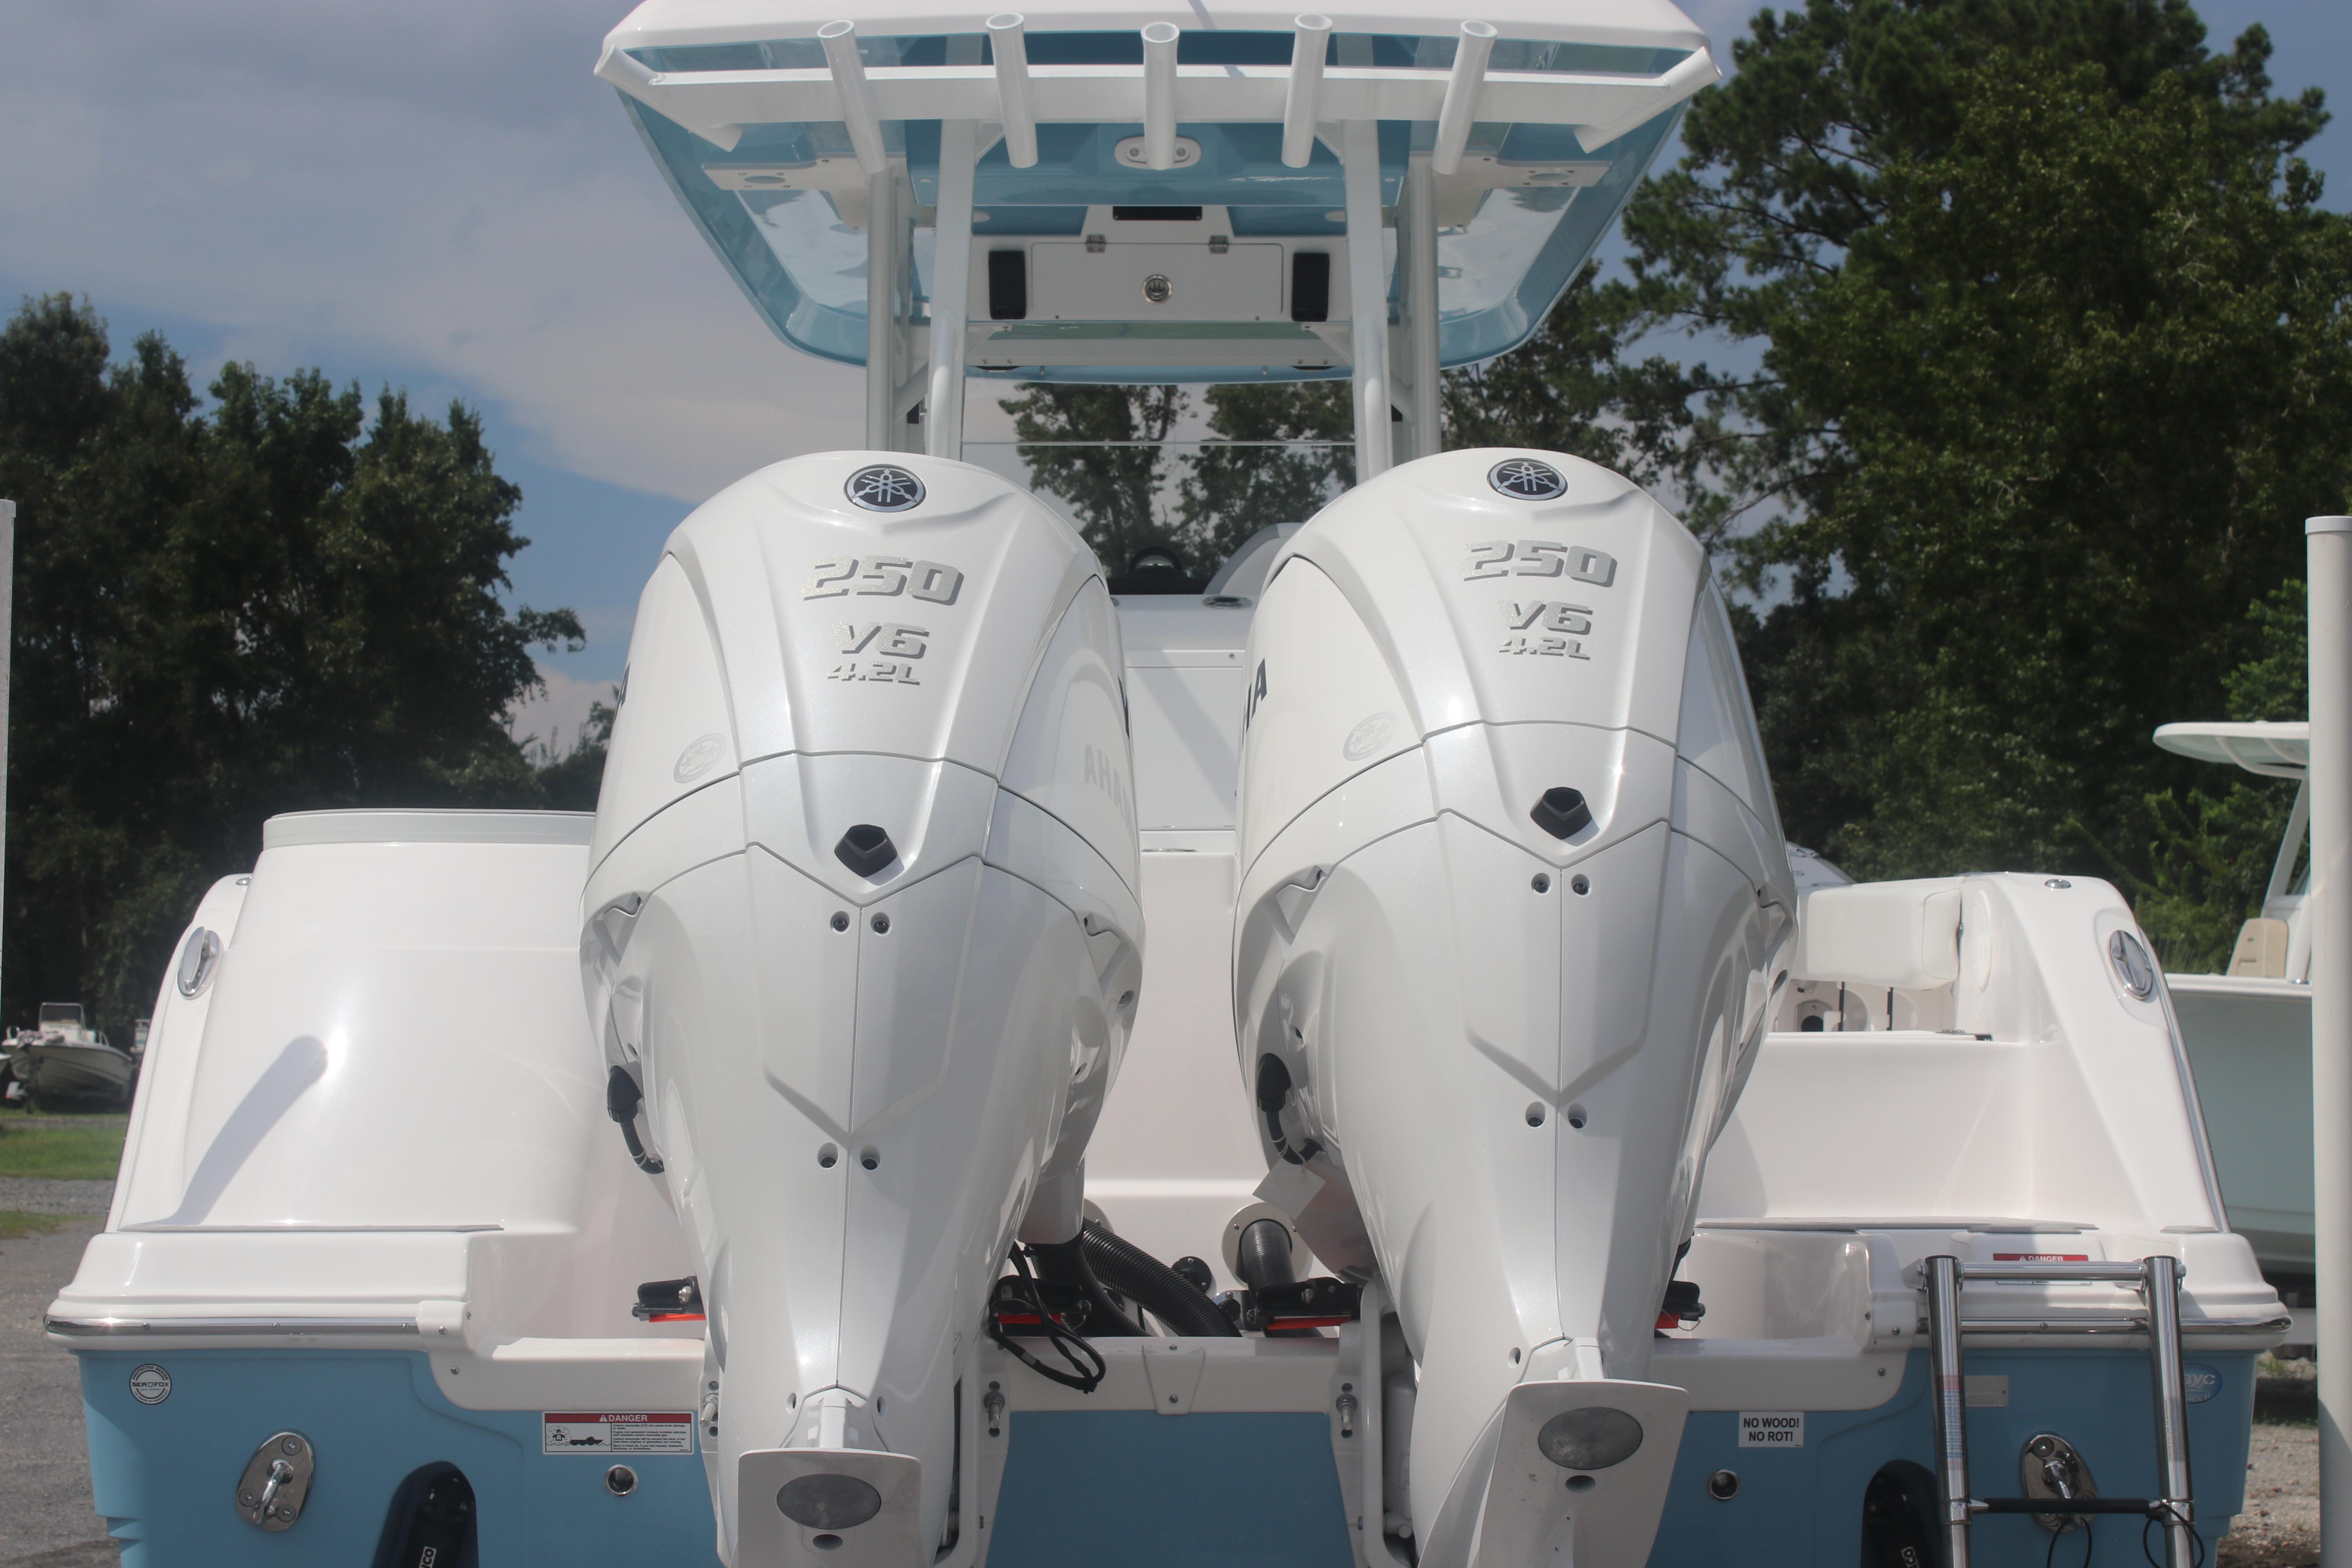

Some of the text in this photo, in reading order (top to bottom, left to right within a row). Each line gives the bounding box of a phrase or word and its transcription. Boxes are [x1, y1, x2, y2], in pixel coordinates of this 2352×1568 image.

[1457, 540, 1617, 588] 250
[798, 555, 964, 606] 250
[1496, 600, 1593, 635] V6
[832, 622, 930, 659] V6
[1495, 635, 1590, 661] 4.2L
[825, 661, 920, 685] 4.2L
[132, 1366, 169, 1380] PROTECTED DESIGN
[2184, 1374, 2216, 1386] BYC
[1744, 1418, 1799, 1428] NO WOOD!
[1749, 1432, 1793, 1441] NO ROT!
